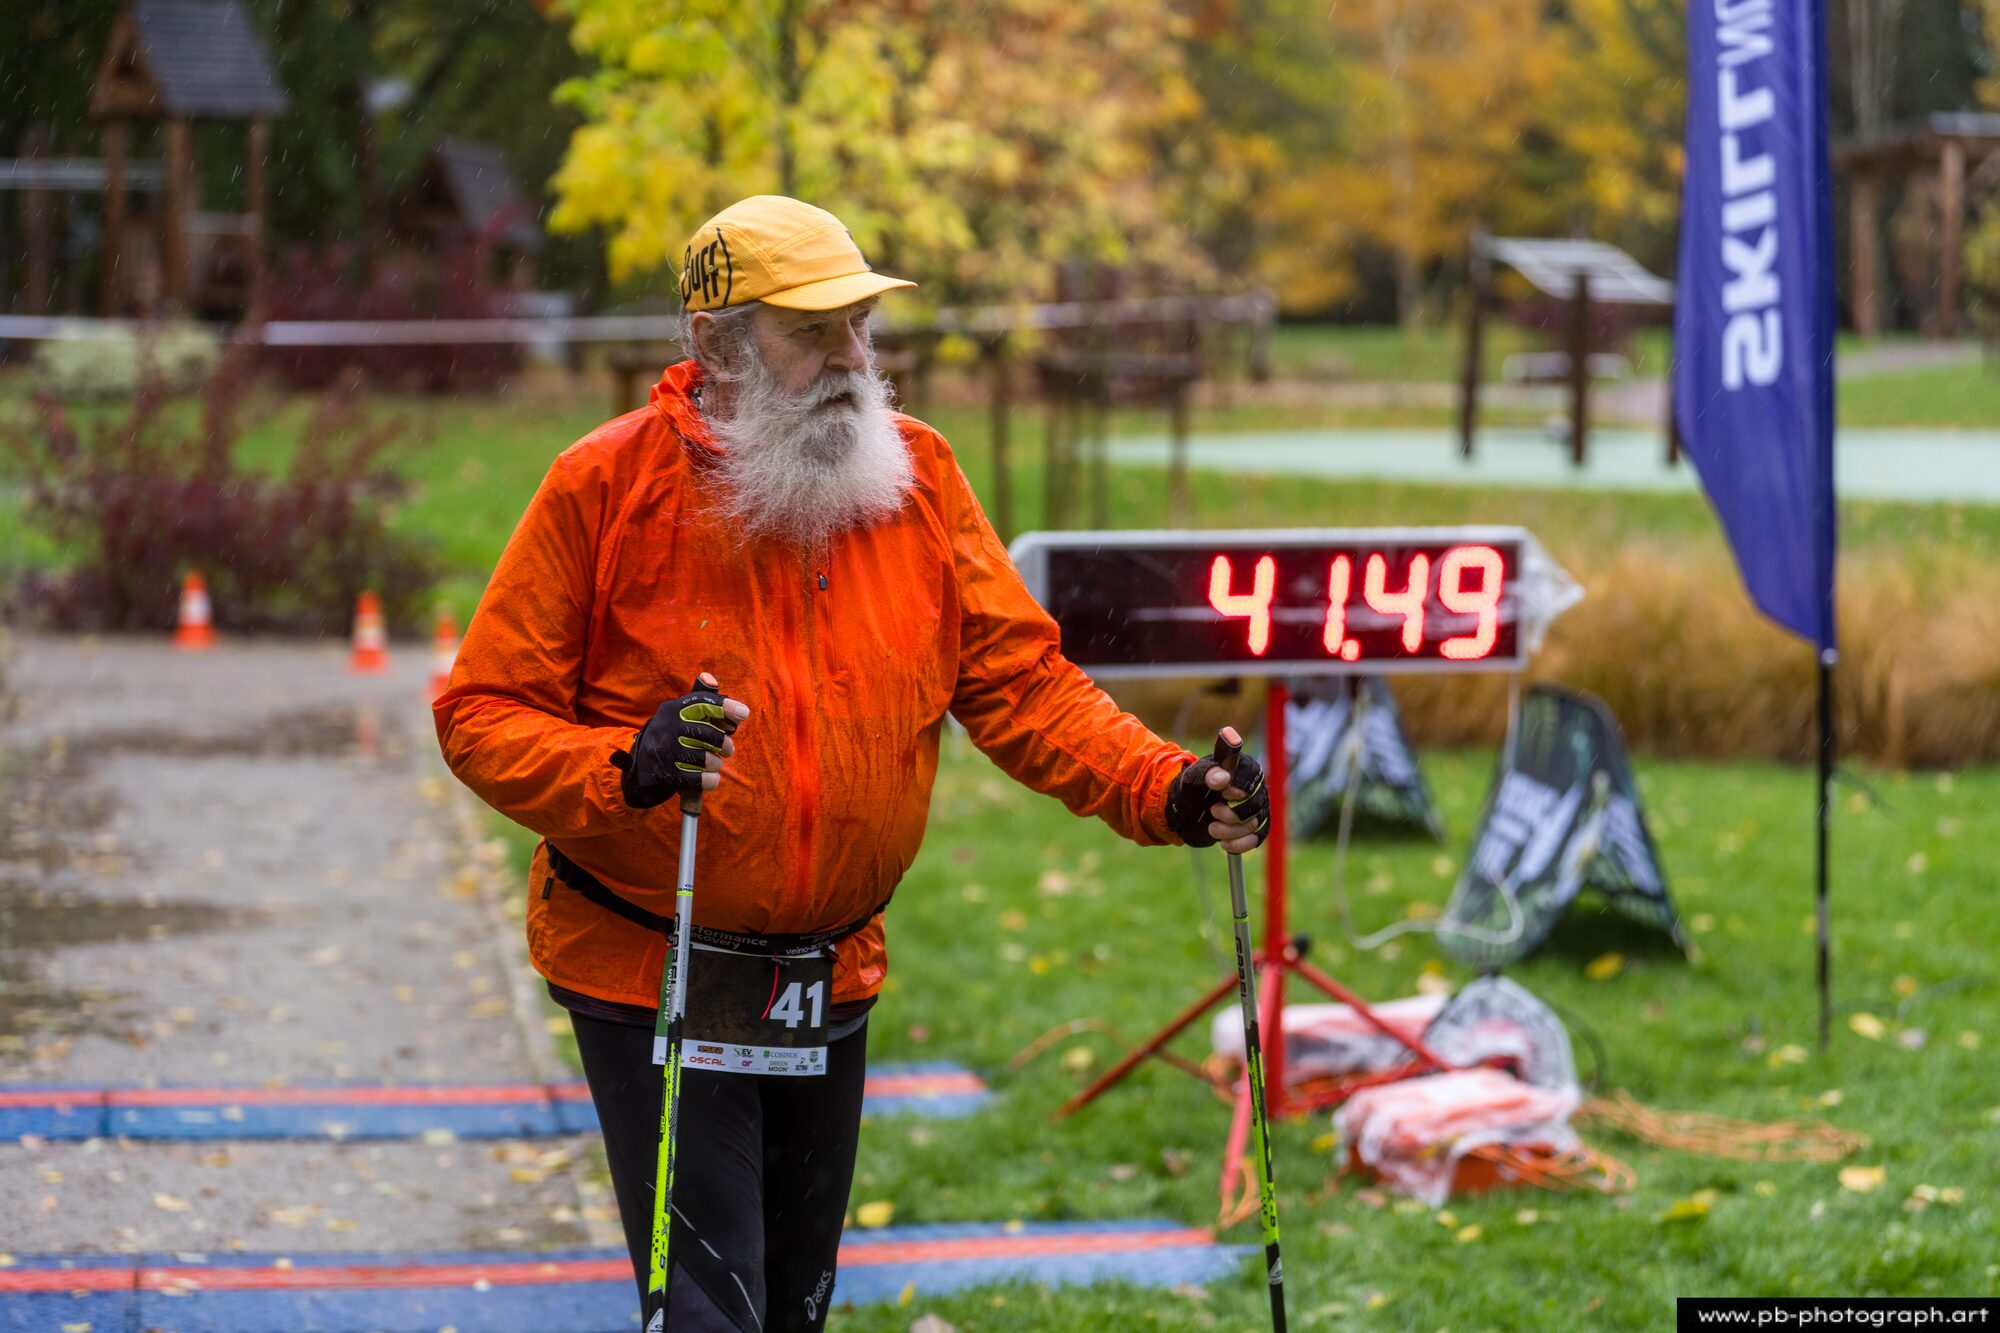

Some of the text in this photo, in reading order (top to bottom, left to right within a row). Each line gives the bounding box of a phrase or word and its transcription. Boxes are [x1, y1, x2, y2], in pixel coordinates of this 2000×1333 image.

[690, 932, 741, 950] ecovery
[769, 980, 824, 1029] 41
[689, 1056, 726, 1067] OSCAL
[811, 1270, 832, 1304] asics
